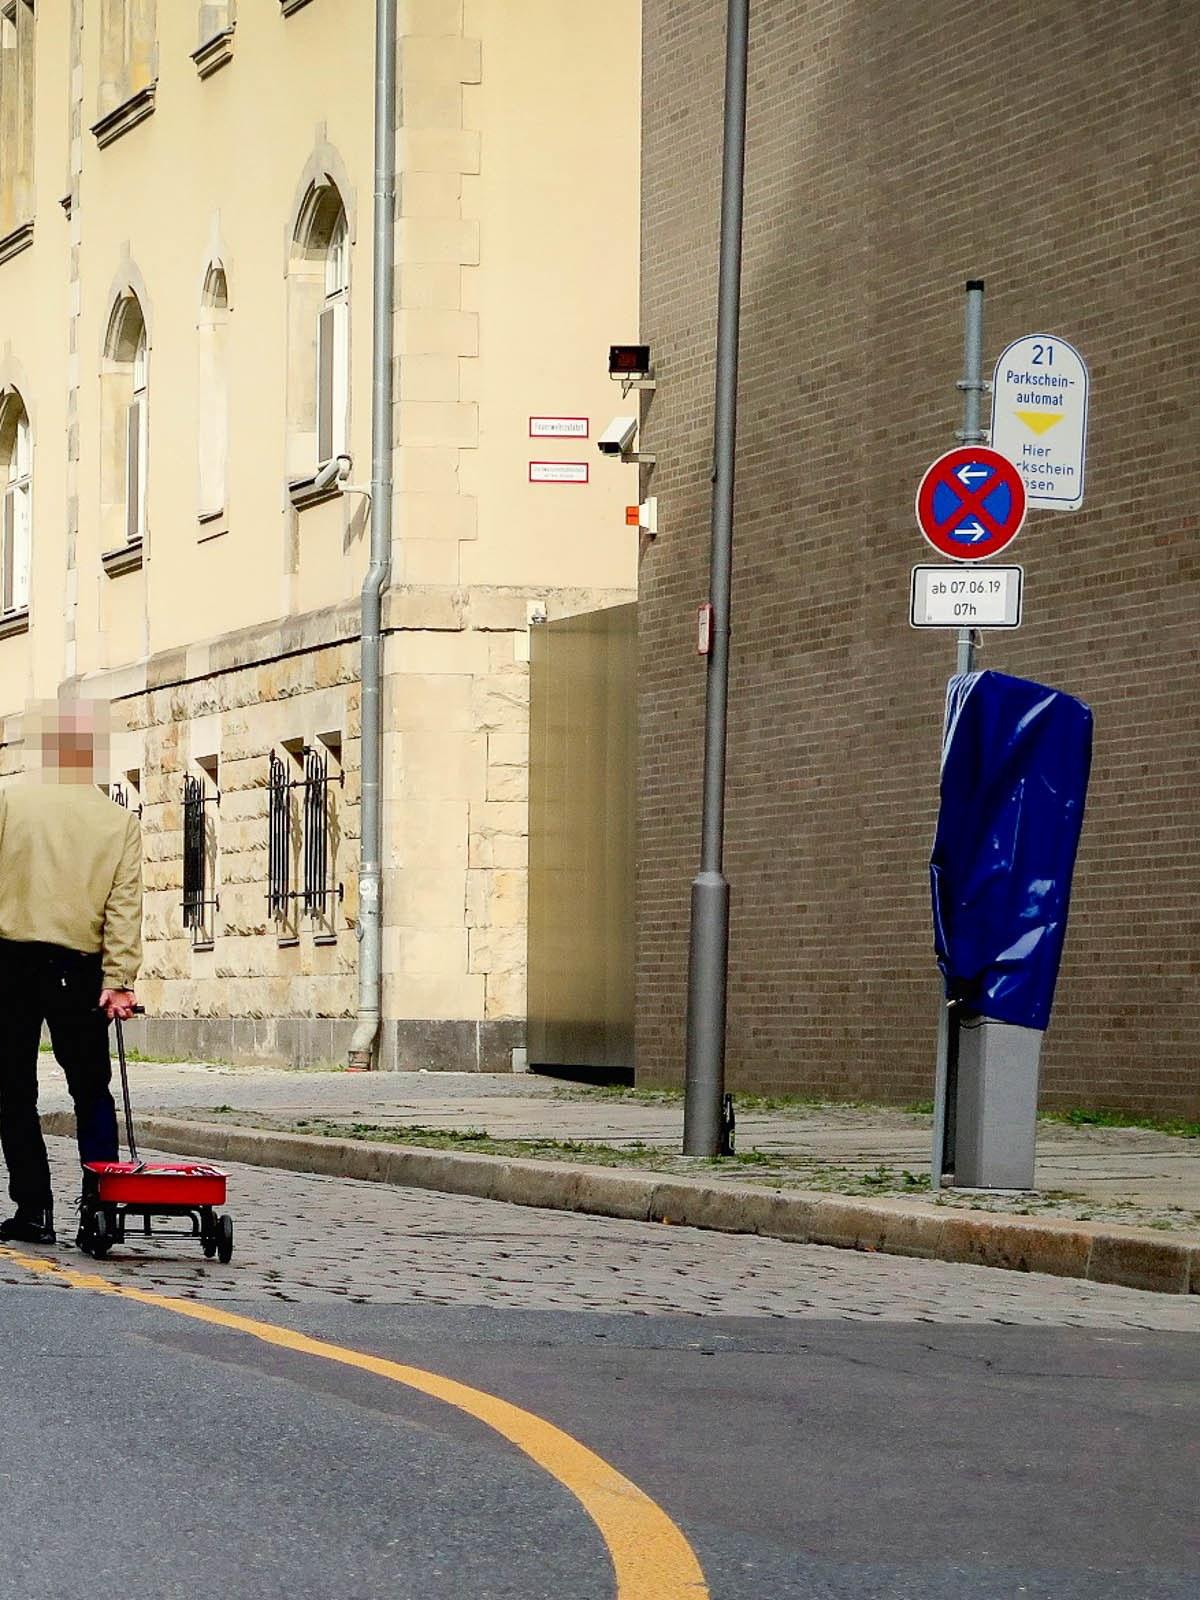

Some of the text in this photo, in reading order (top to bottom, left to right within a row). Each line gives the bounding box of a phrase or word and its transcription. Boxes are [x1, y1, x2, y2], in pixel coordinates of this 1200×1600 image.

[1032, 344, 1053, 366] 21
[1006, 370, 1075, 388] Parkschein-
[1016, 392, 1063, 406] automat
[1022, 444, 1052, 457] Hier
[1016, 460, 1074, 476] rkschein
[1024, 476, 1055, 491] ösen
[931, 580, 1001, 594] ab 07.06.19
[954, 603, 977, 616] 07h
